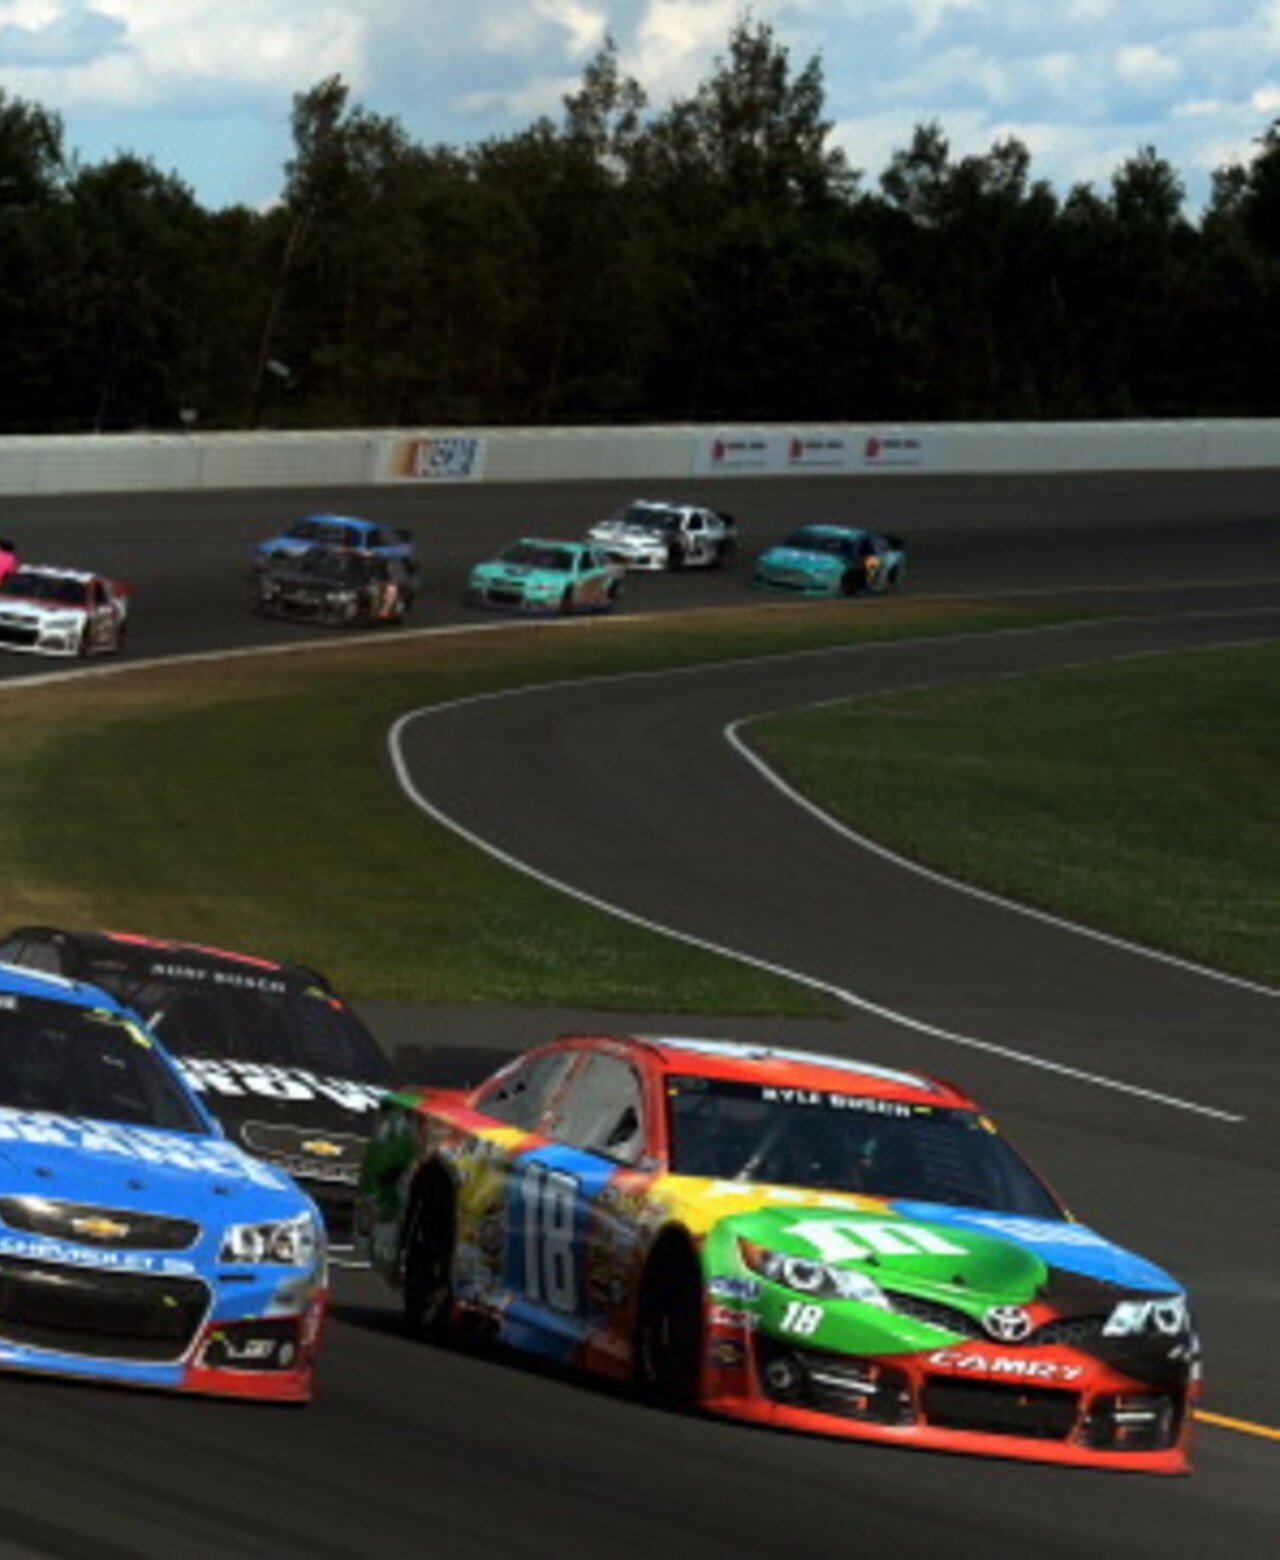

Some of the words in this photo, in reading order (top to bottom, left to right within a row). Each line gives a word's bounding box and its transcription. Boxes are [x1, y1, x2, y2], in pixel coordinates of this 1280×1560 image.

[762, 1086, 820, 1105] KYLE
[829, 1093, 911, 1118] BUSCH
[522, 1160, 577, 1312] 18
[0, 1237, 154, 1269] CHEVROLET
[778, 1301, 824, 1336] 18
[927, 1349, 1085, 1381] CAMRY
